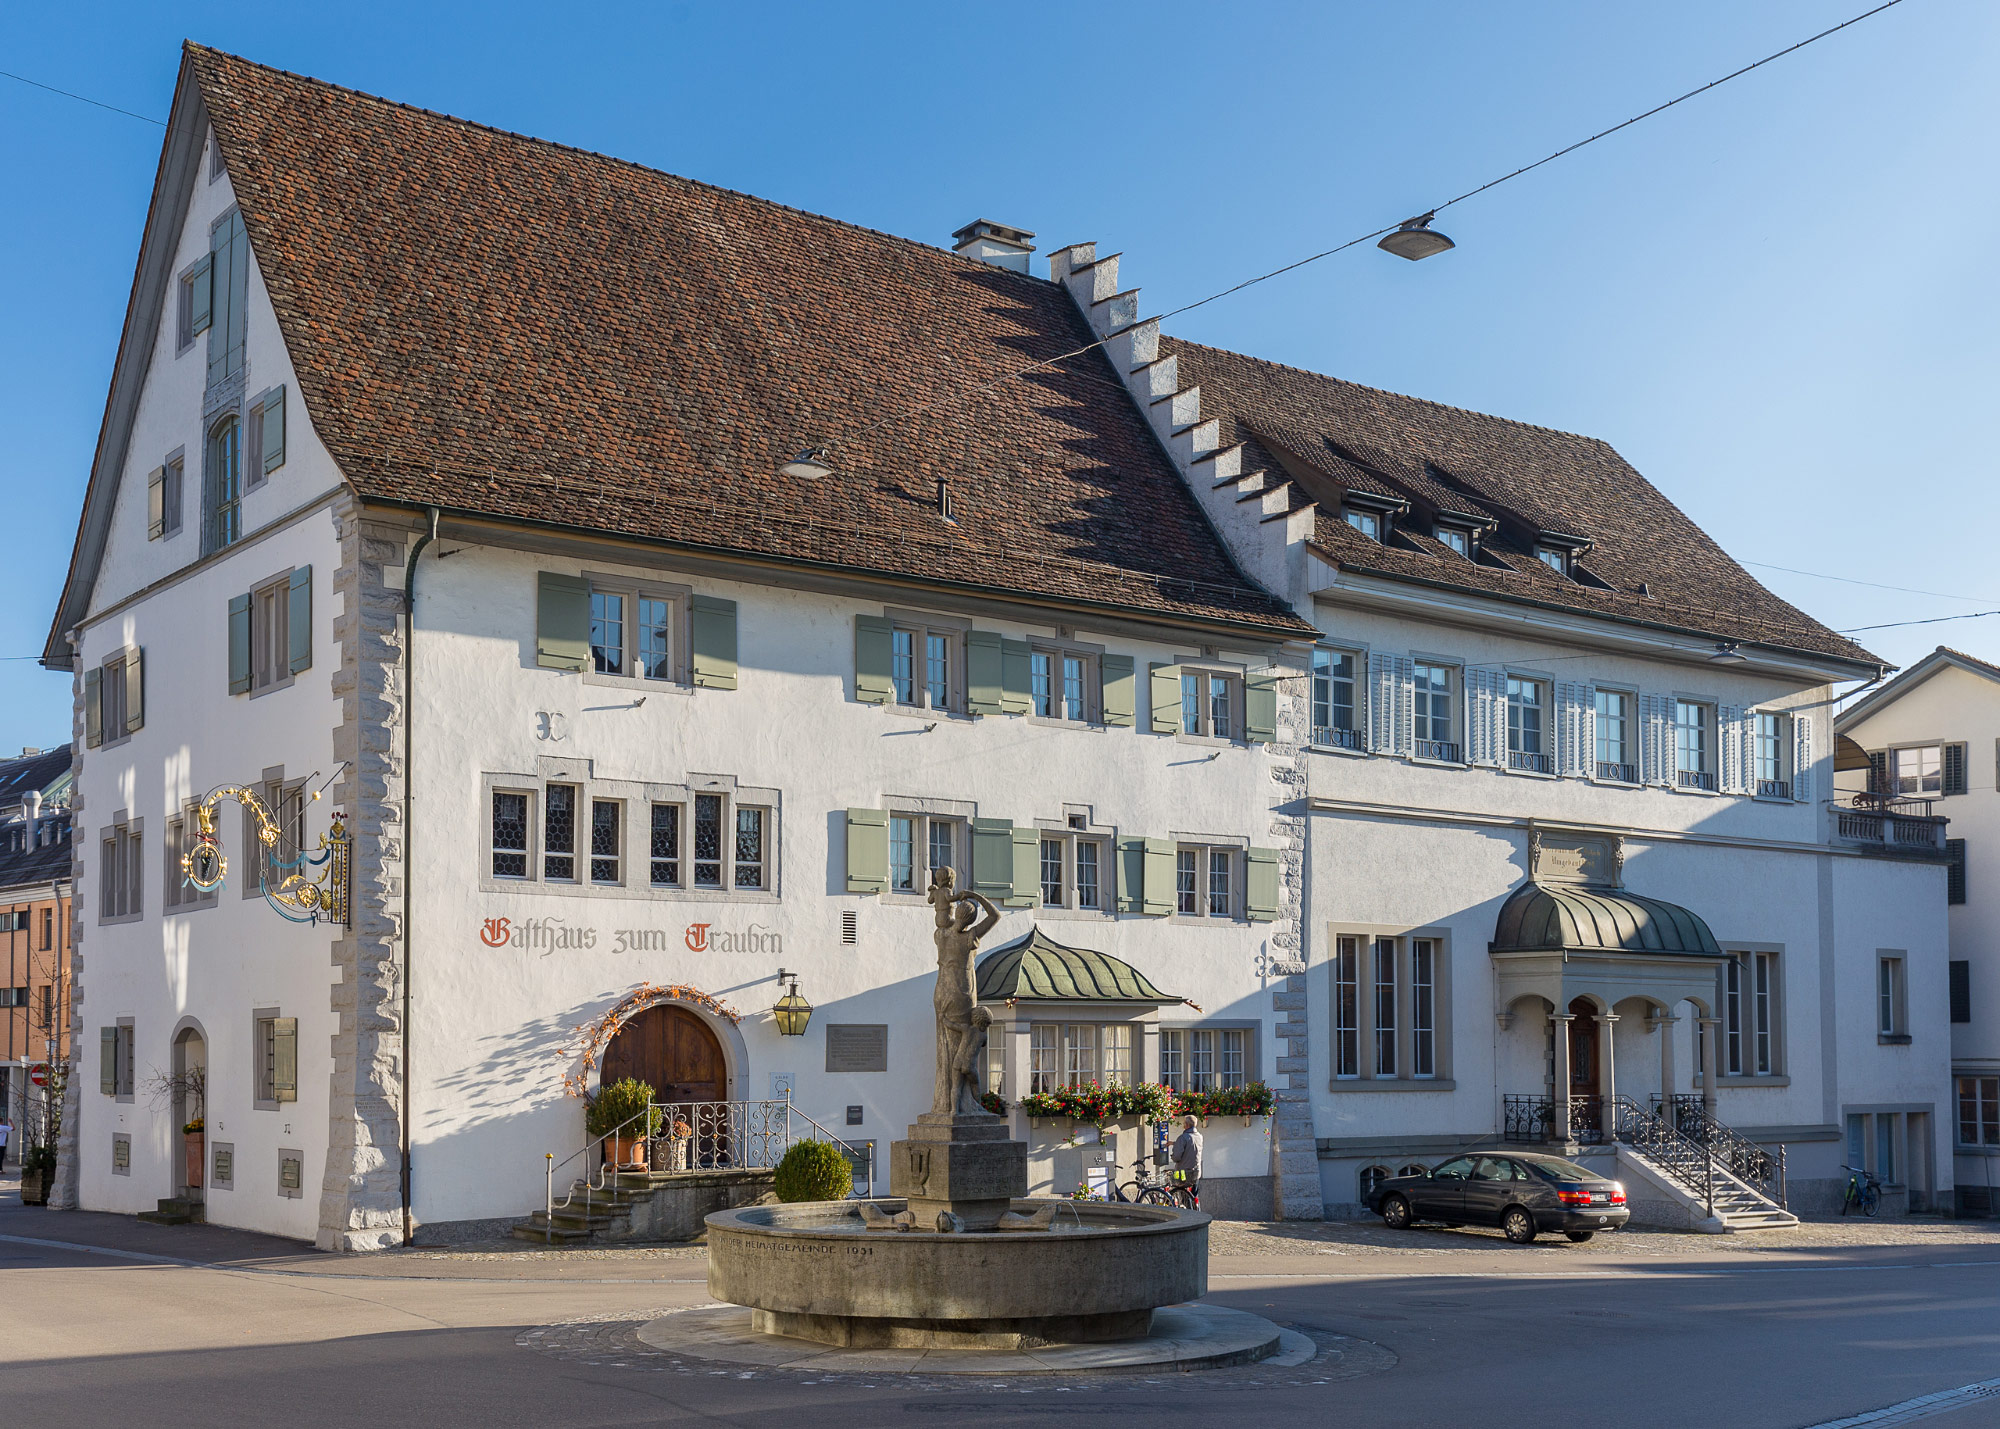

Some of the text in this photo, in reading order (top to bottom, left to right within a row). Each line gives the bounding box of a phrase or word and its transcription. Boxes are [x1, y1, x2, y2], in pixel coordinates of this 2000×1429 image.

[612, 928, 666, 954] zum
[685, 923, 783, 954] Trauben
[952, 1175, 1024, 1187] VERFASSUNG
[746, 1240, 837, 1254] HEIMATGEMEINDE
